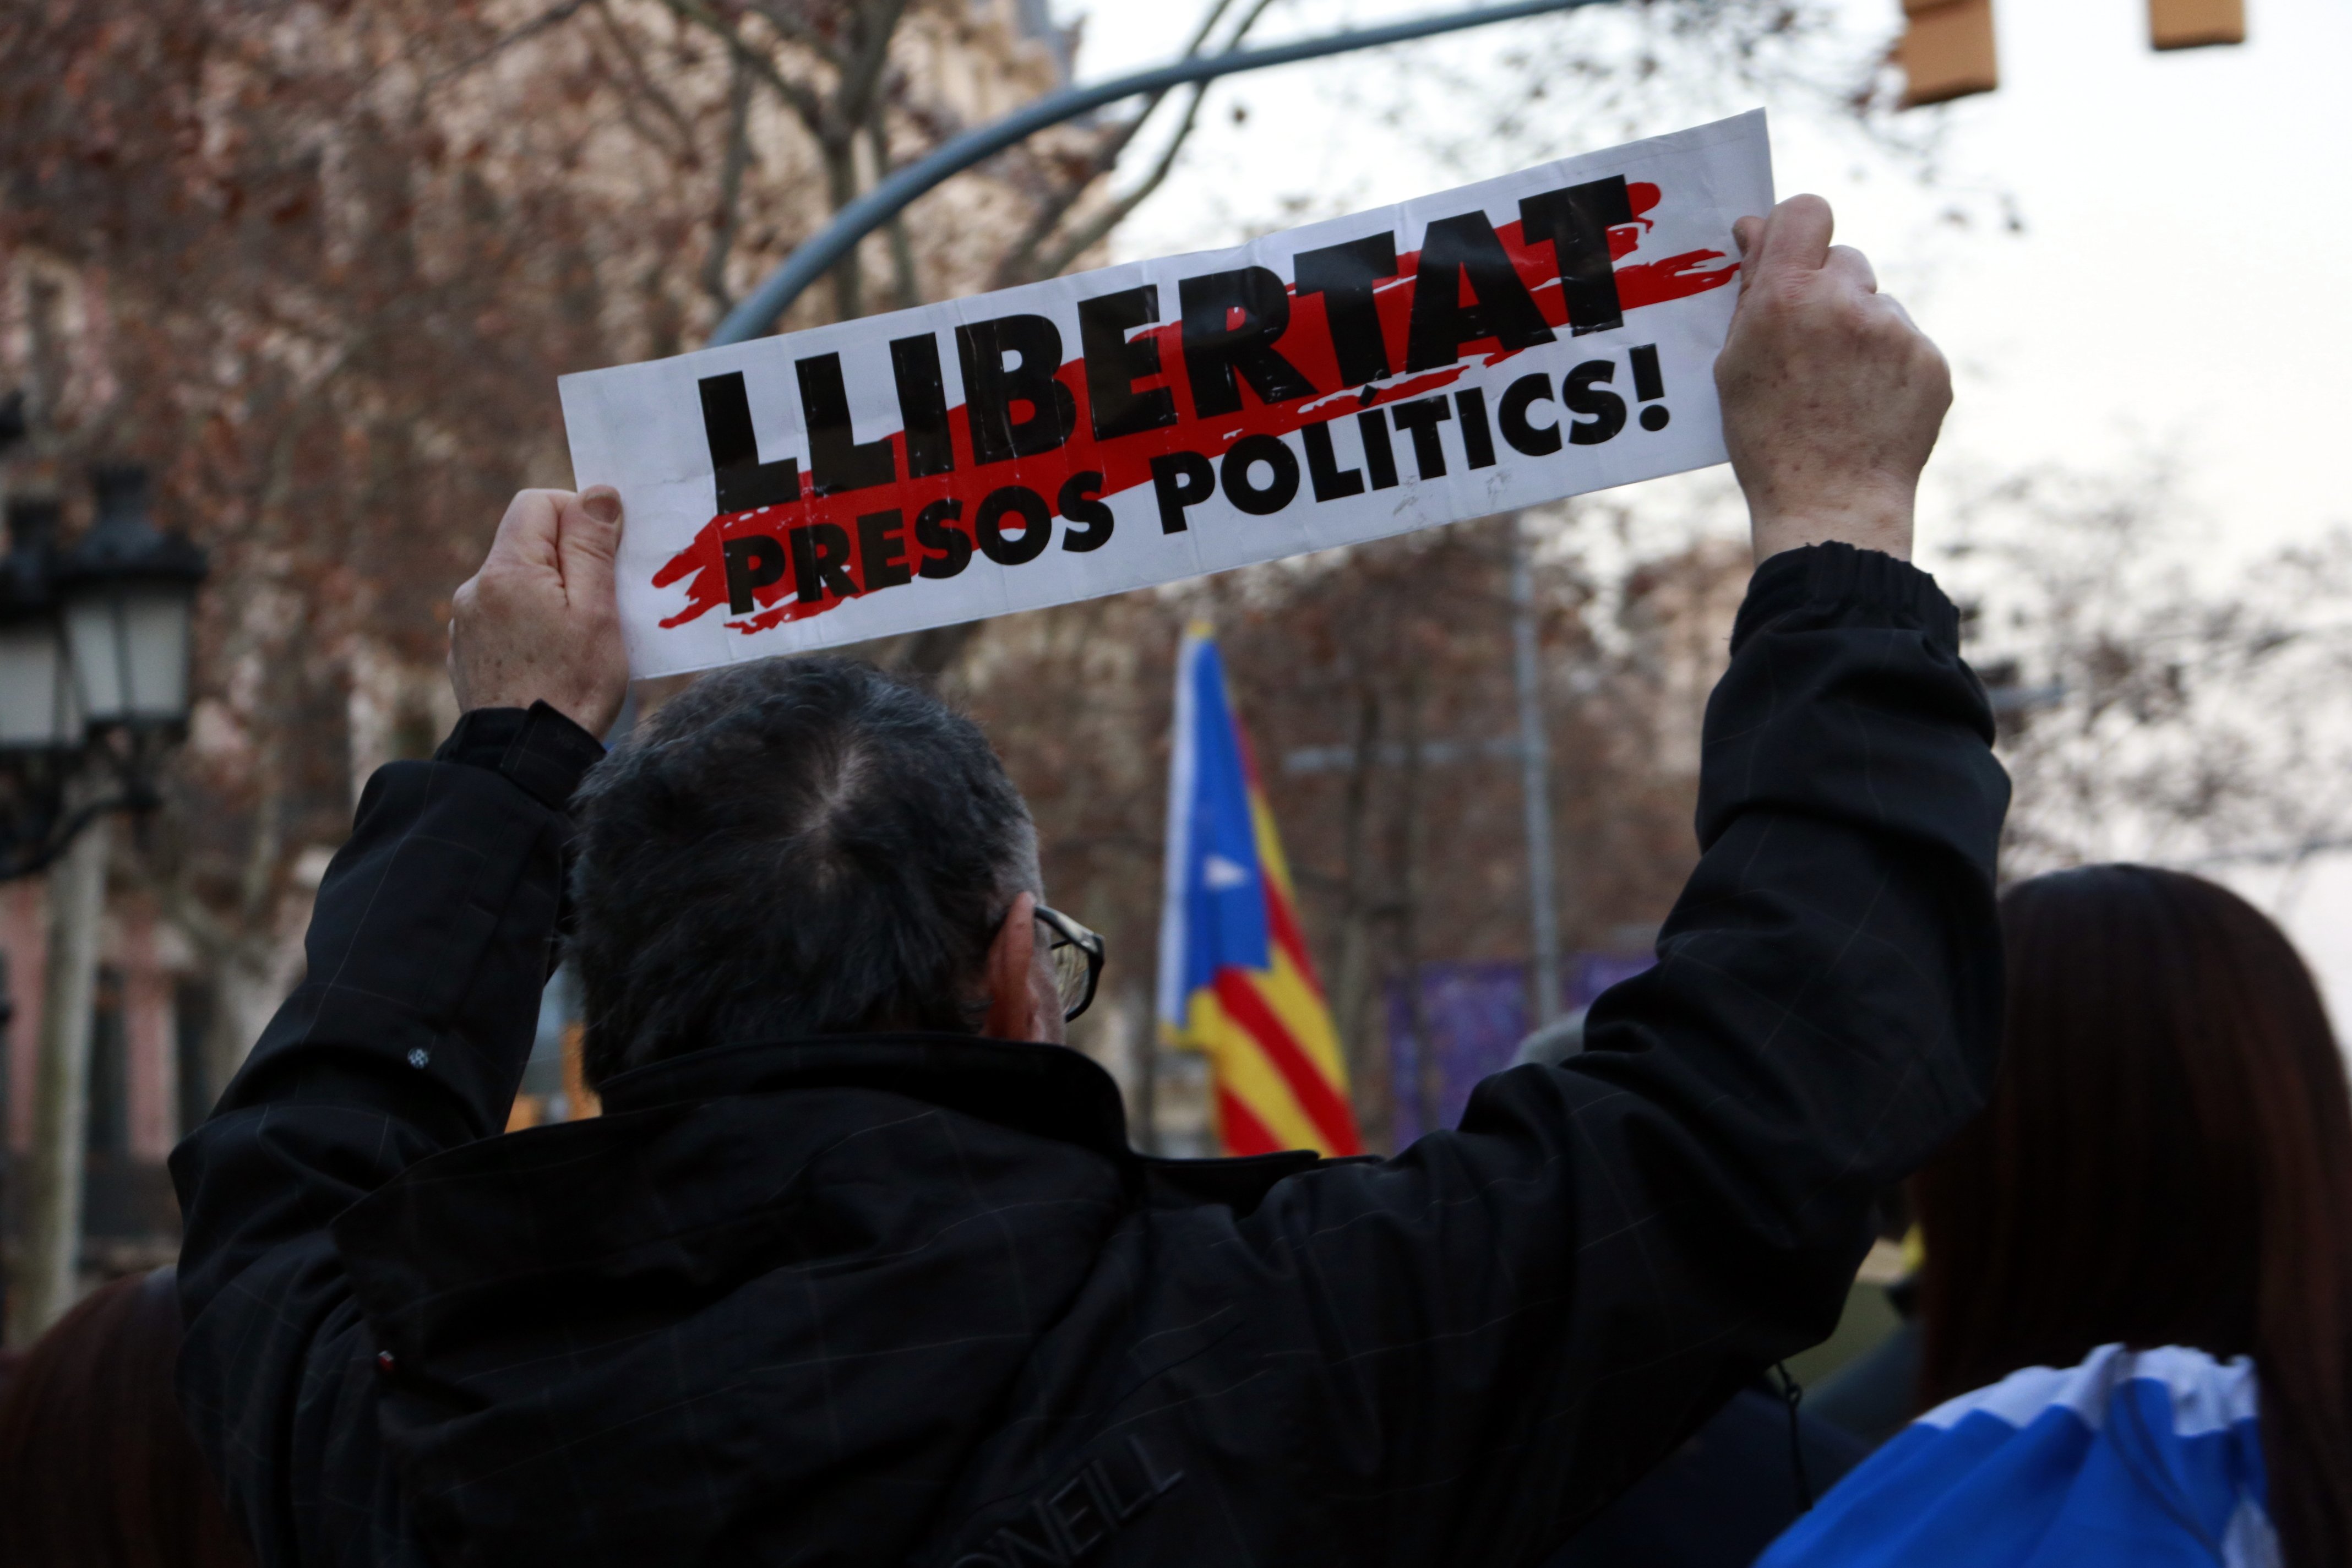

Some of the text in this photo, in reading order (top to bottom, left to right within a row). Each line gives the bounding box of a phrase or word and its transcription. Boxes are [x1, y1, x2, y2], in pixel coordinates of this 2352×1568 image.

[698, 175, 1633, 516] LLIBERTAT
[723, 343, 1669, 616] PRESOS POLÍTICS!
